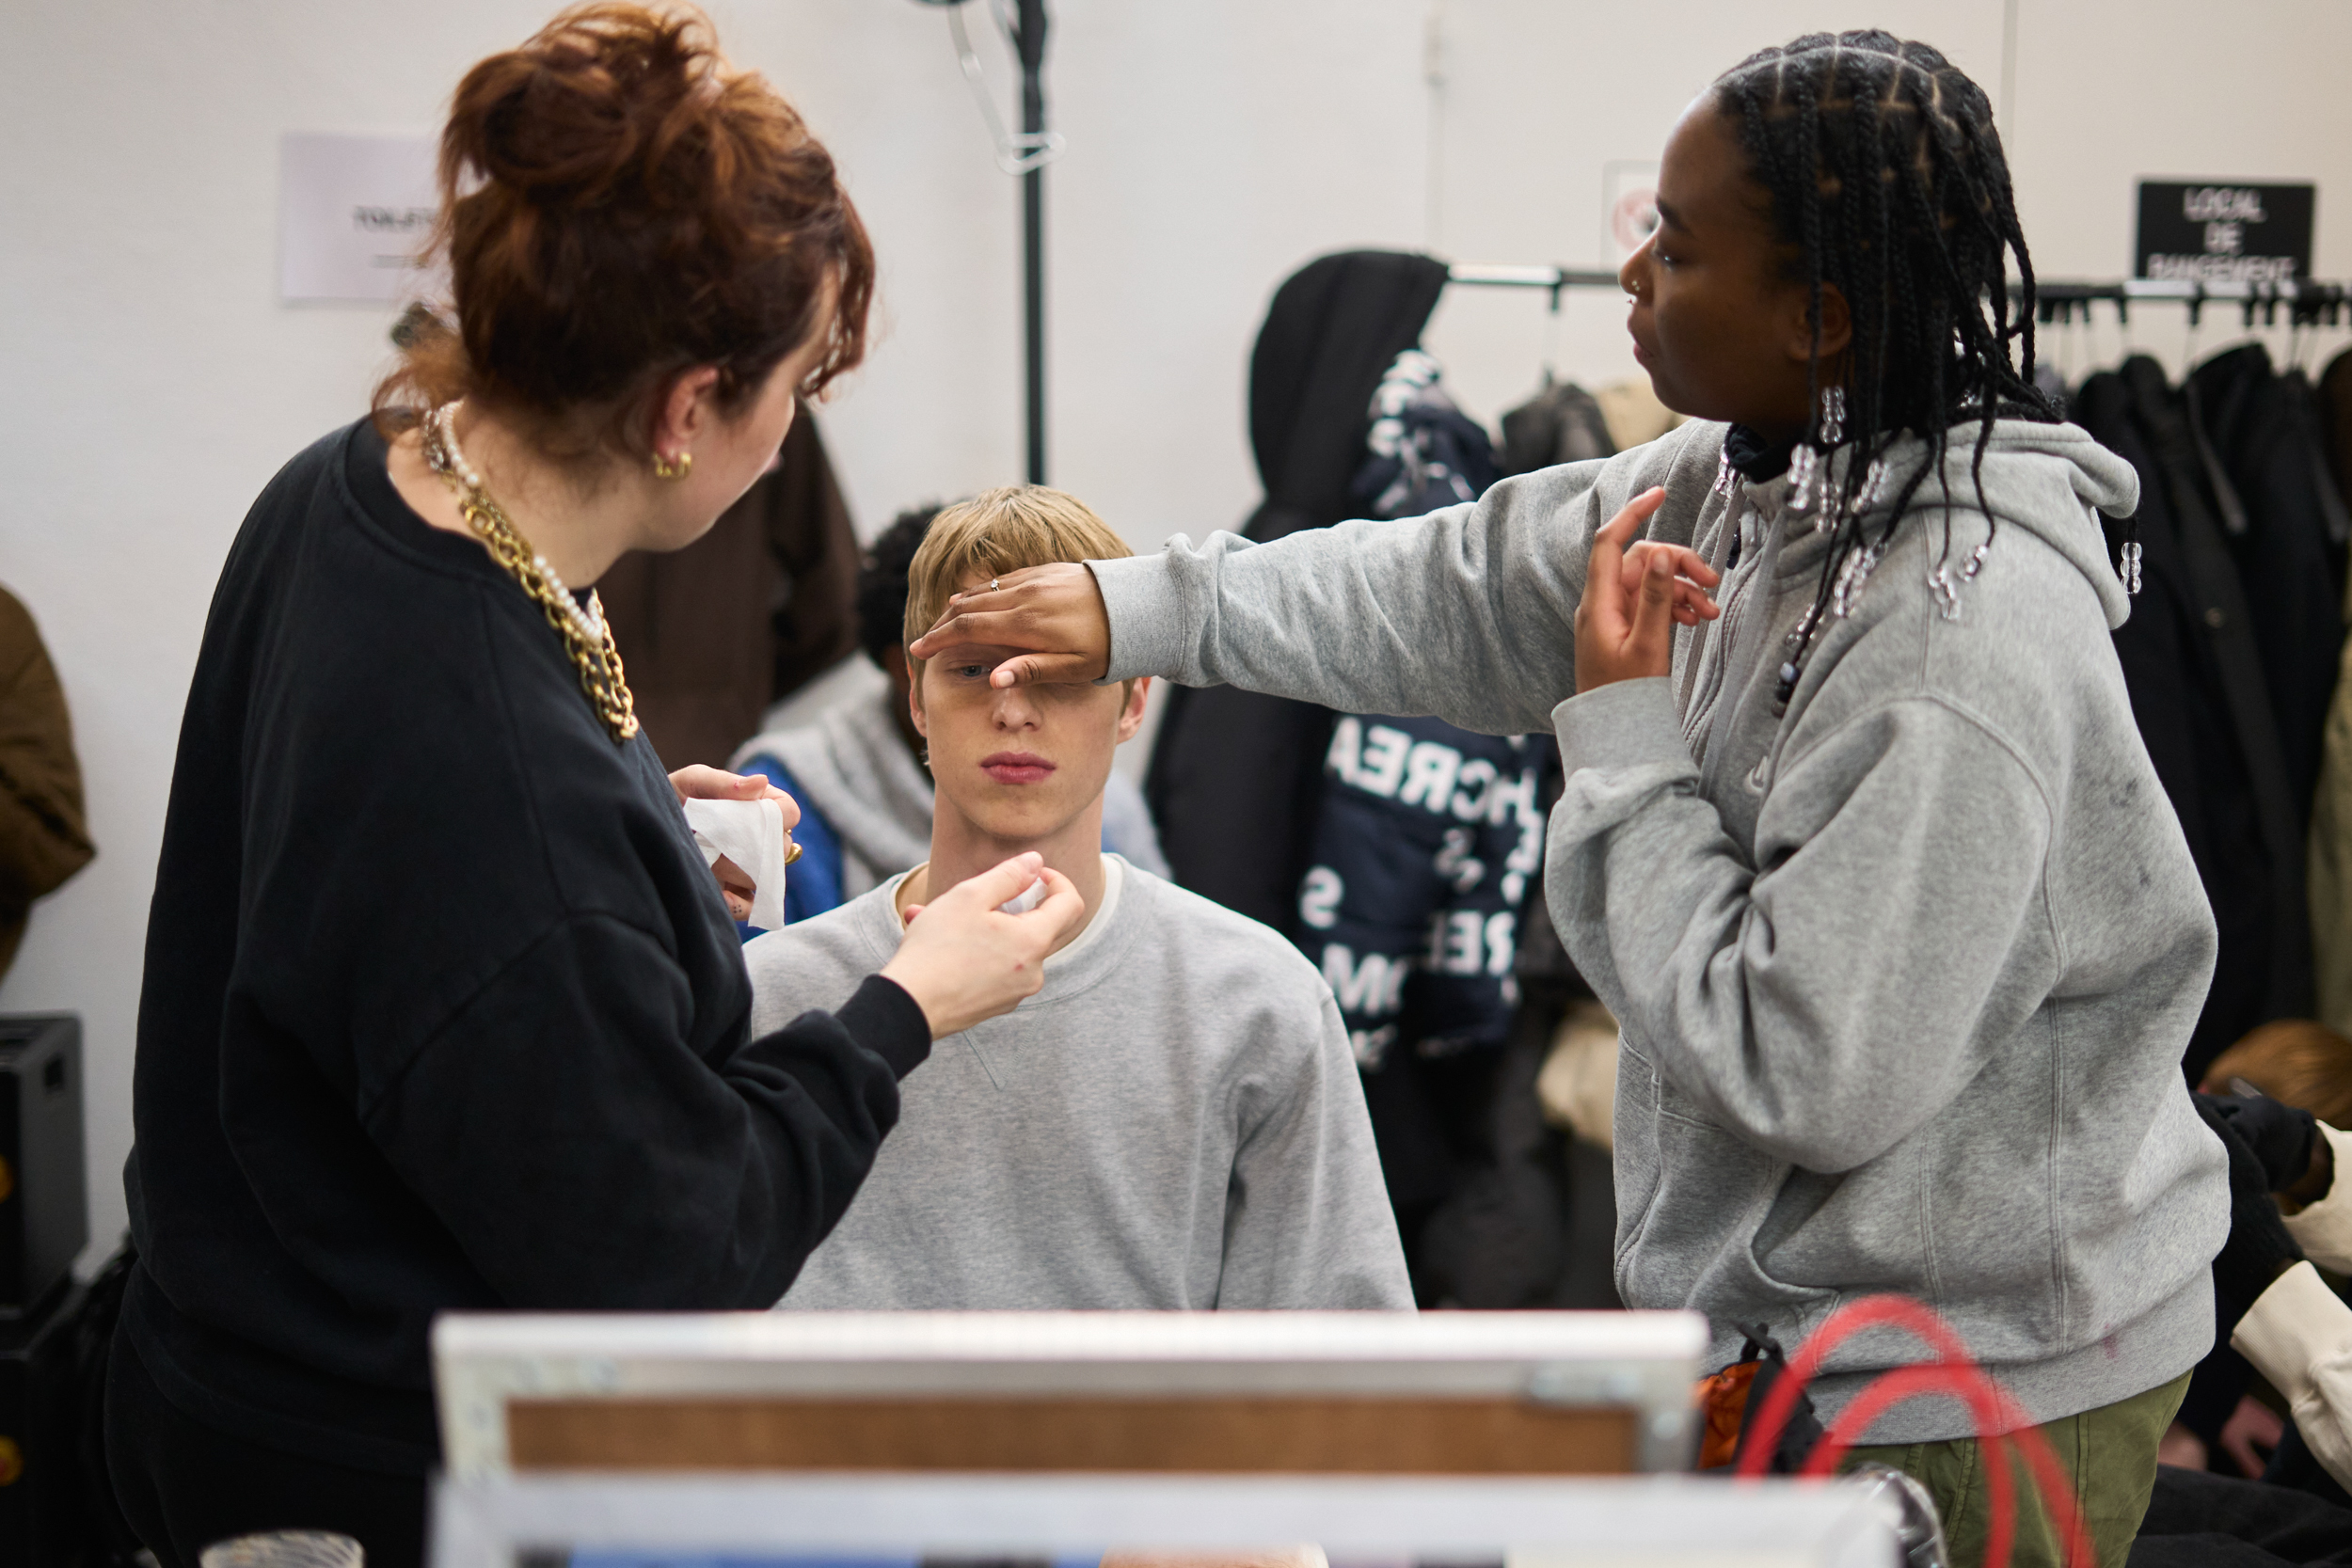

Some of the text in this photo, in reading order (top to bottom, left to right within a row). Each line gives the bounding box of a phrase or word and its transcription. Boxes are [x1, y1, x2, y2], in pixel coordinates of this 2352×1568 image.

[2184, 187, 2267, 223] LOCAL
[2203, 222, 2246, 256] DE
[2146, 253, 2297, 282] RANGEMENT
